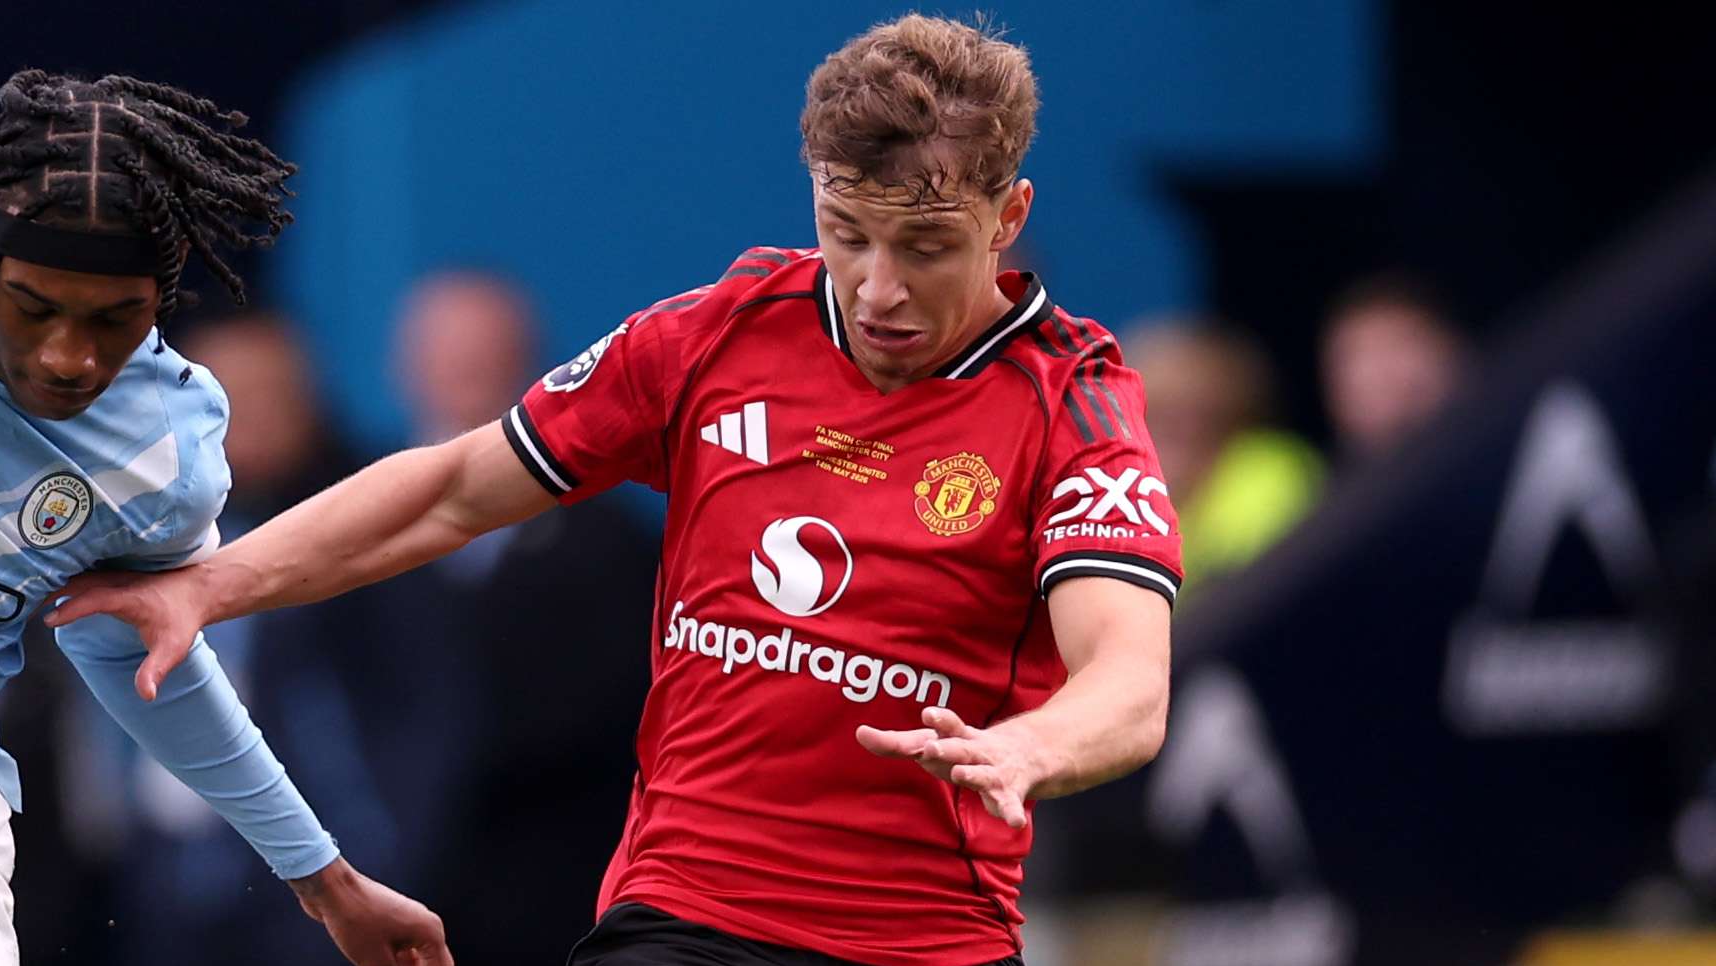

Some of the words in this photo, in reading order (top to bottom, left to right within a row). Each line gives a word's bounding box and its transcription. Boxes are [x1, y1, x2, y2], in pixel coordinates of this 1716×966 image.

[815, 425, 828, 436] FA
[828, 428, 854, 445] YOUTH
[872, 441, 895, 454] FINAL
[871, 449, 890, 461] CITY
[832, 465, 851, 479] MAY
[858, 466, 887, 480] UNITED
[931, 457, 994, 496] MANCHESTER
[39, 478, 88, 511] MANCHESTER
[922, 510, 968, 531] UNITED
[30, 533, 50, 543] CITY
[665, 600, 951, 707] Snapdragon
